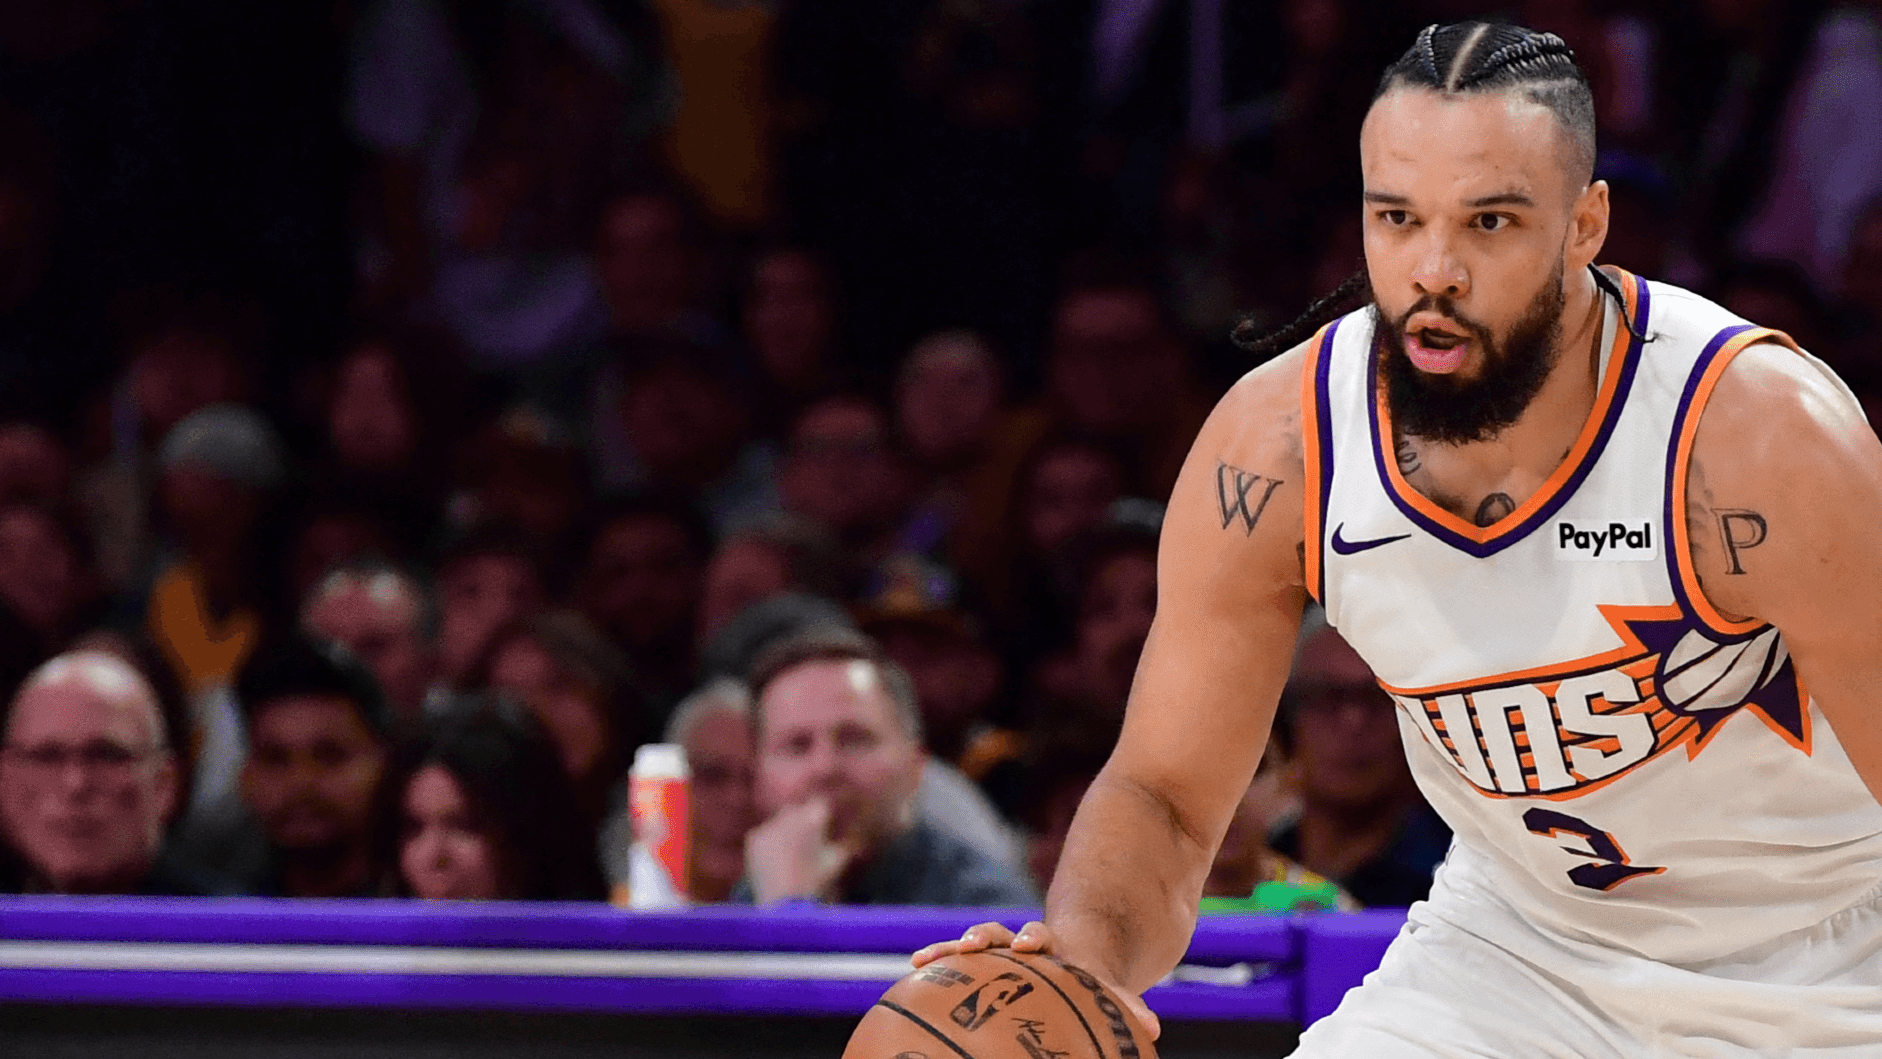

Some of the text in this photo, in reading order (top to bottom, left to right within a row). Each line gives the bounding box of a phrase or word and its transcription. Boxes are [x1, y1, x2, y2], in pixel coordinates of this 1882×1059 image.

[1558, 522, 1652, 557] PayPal
[1710, 507, 1768, 575] P
[1522, 806, 1668, 892] 3
